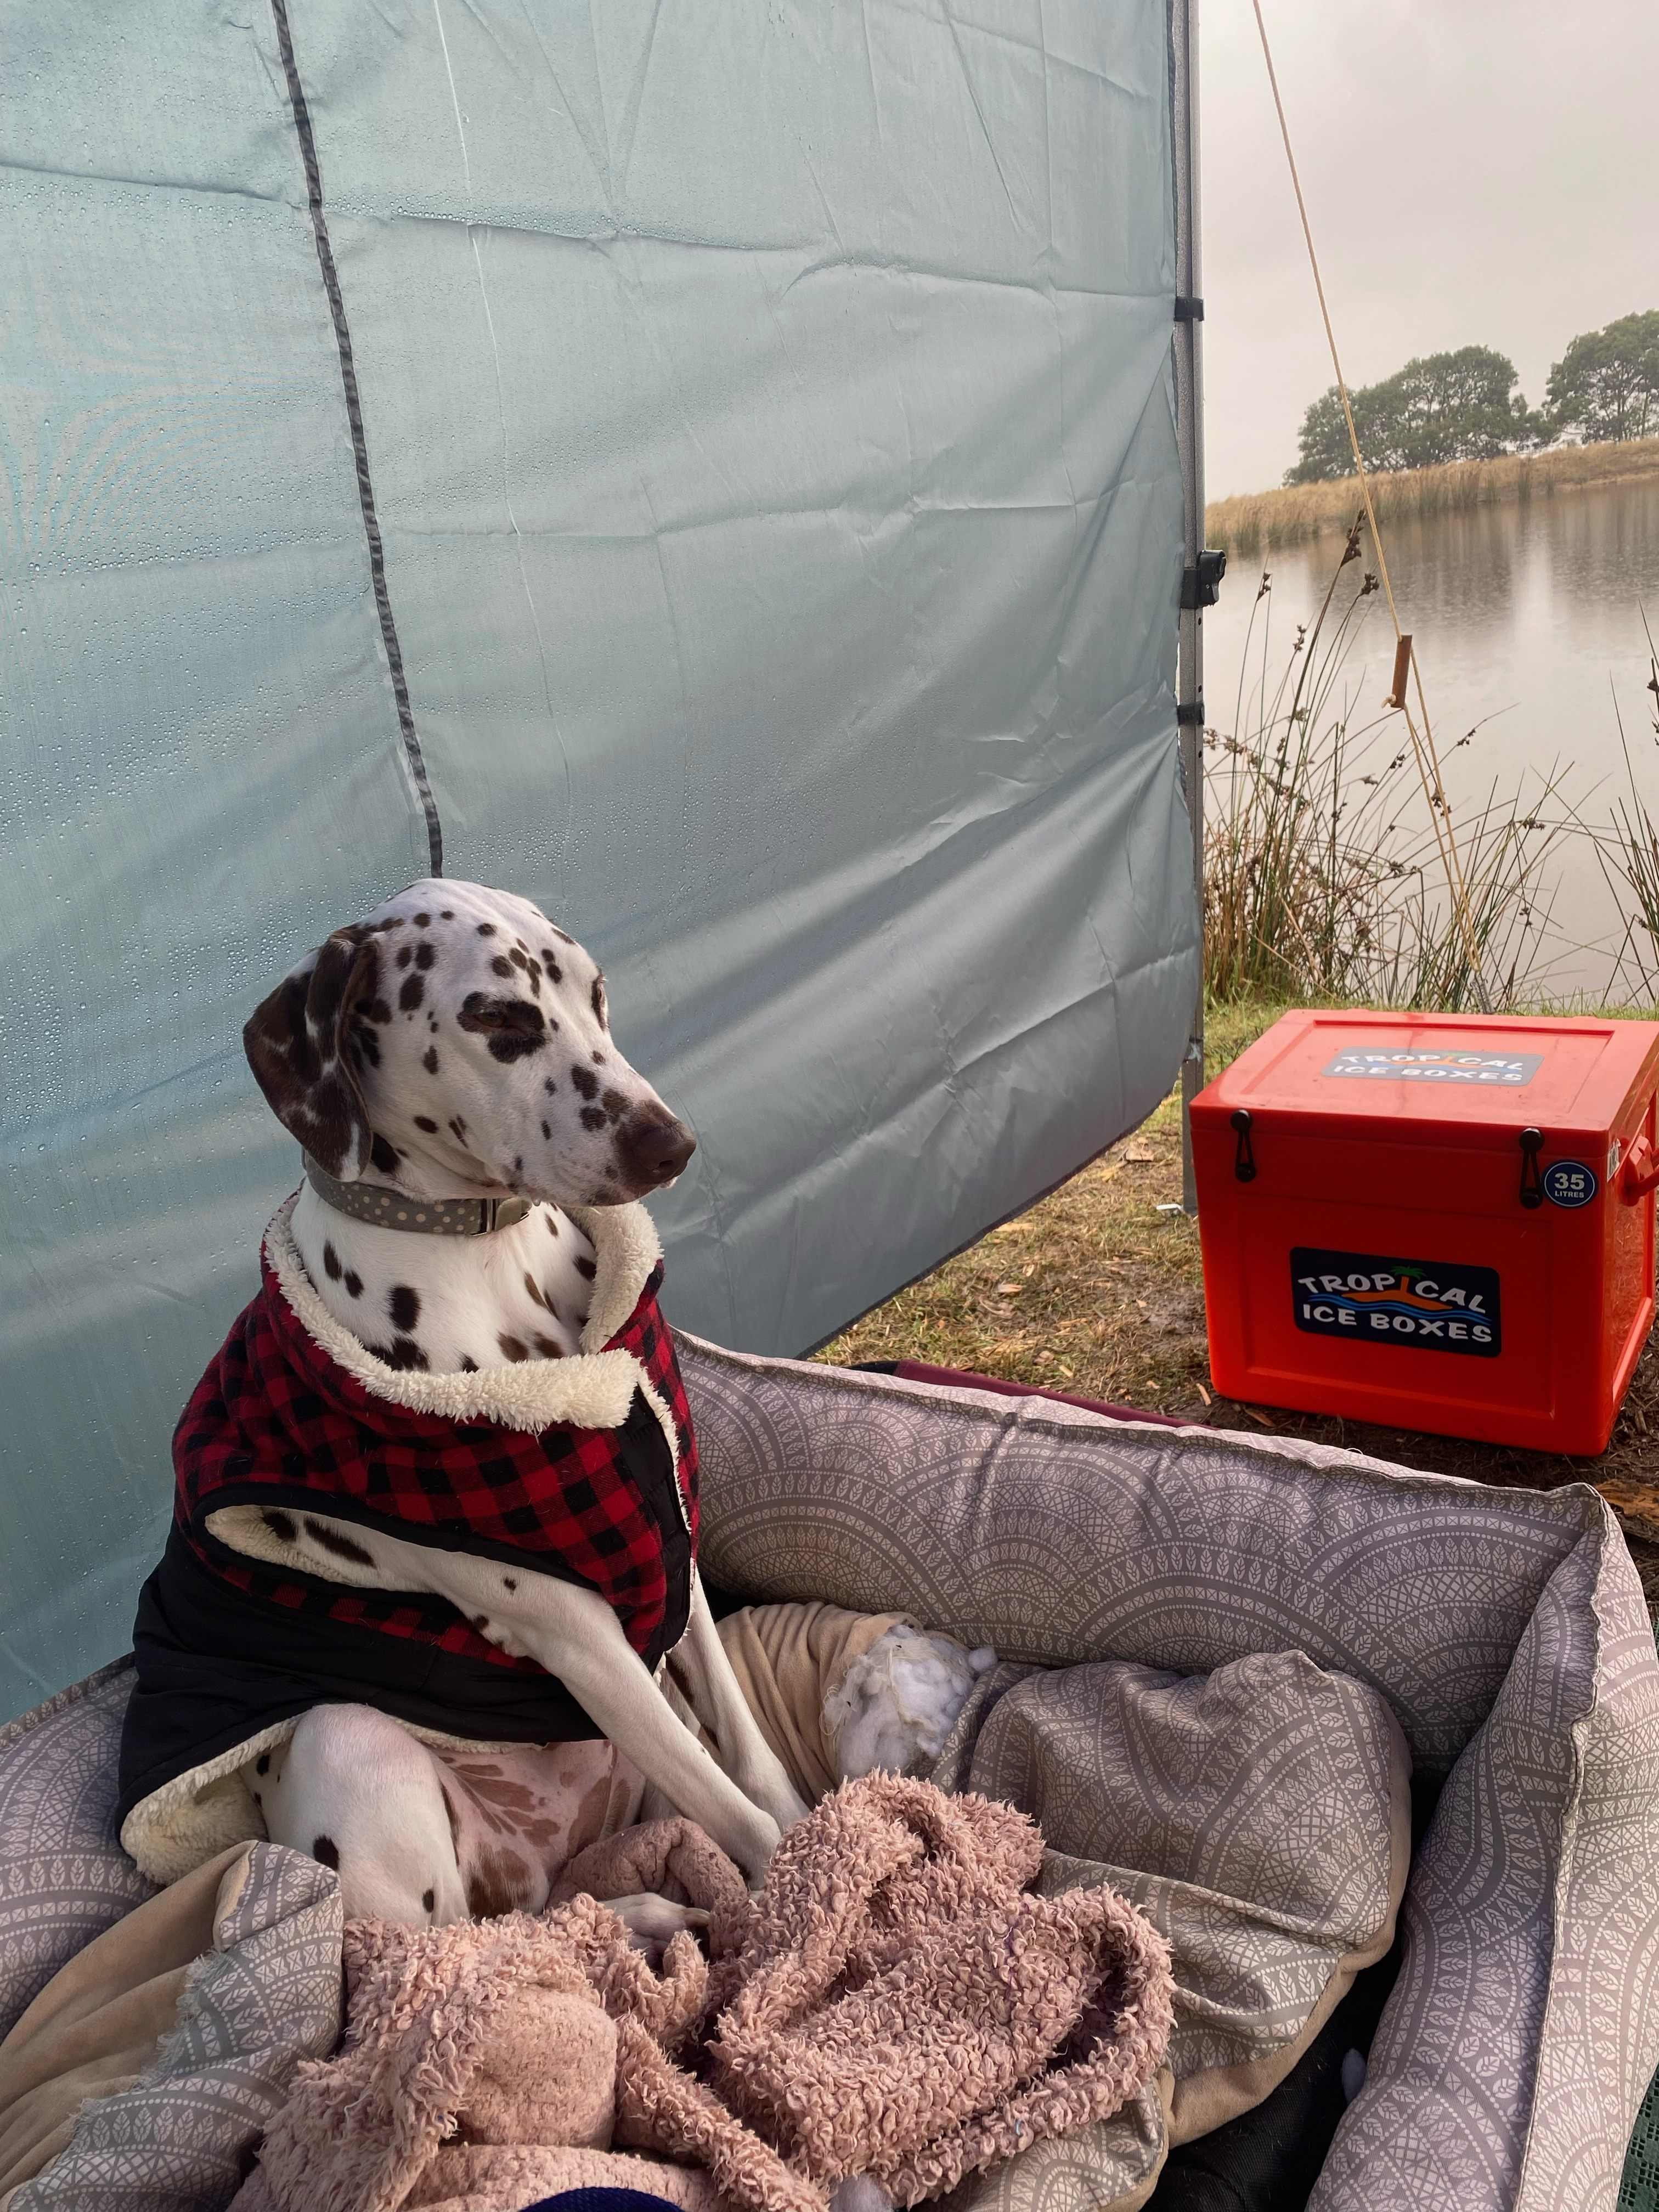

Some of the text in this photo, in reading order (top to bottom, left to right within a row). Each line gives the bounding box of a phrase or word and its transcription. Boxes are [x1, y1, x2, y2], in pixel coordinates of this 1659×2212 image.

[1341, 1054, 1523, 1070] TROPICAL
[1333, 1065, 1523, 1081] ICE BOXES
[1554, 1172, 1585, 1190] 35
[1297, 1273, 1486, 1314] TROPICAL
[1303, 1304, 1492, 1342] ICE BOXES
